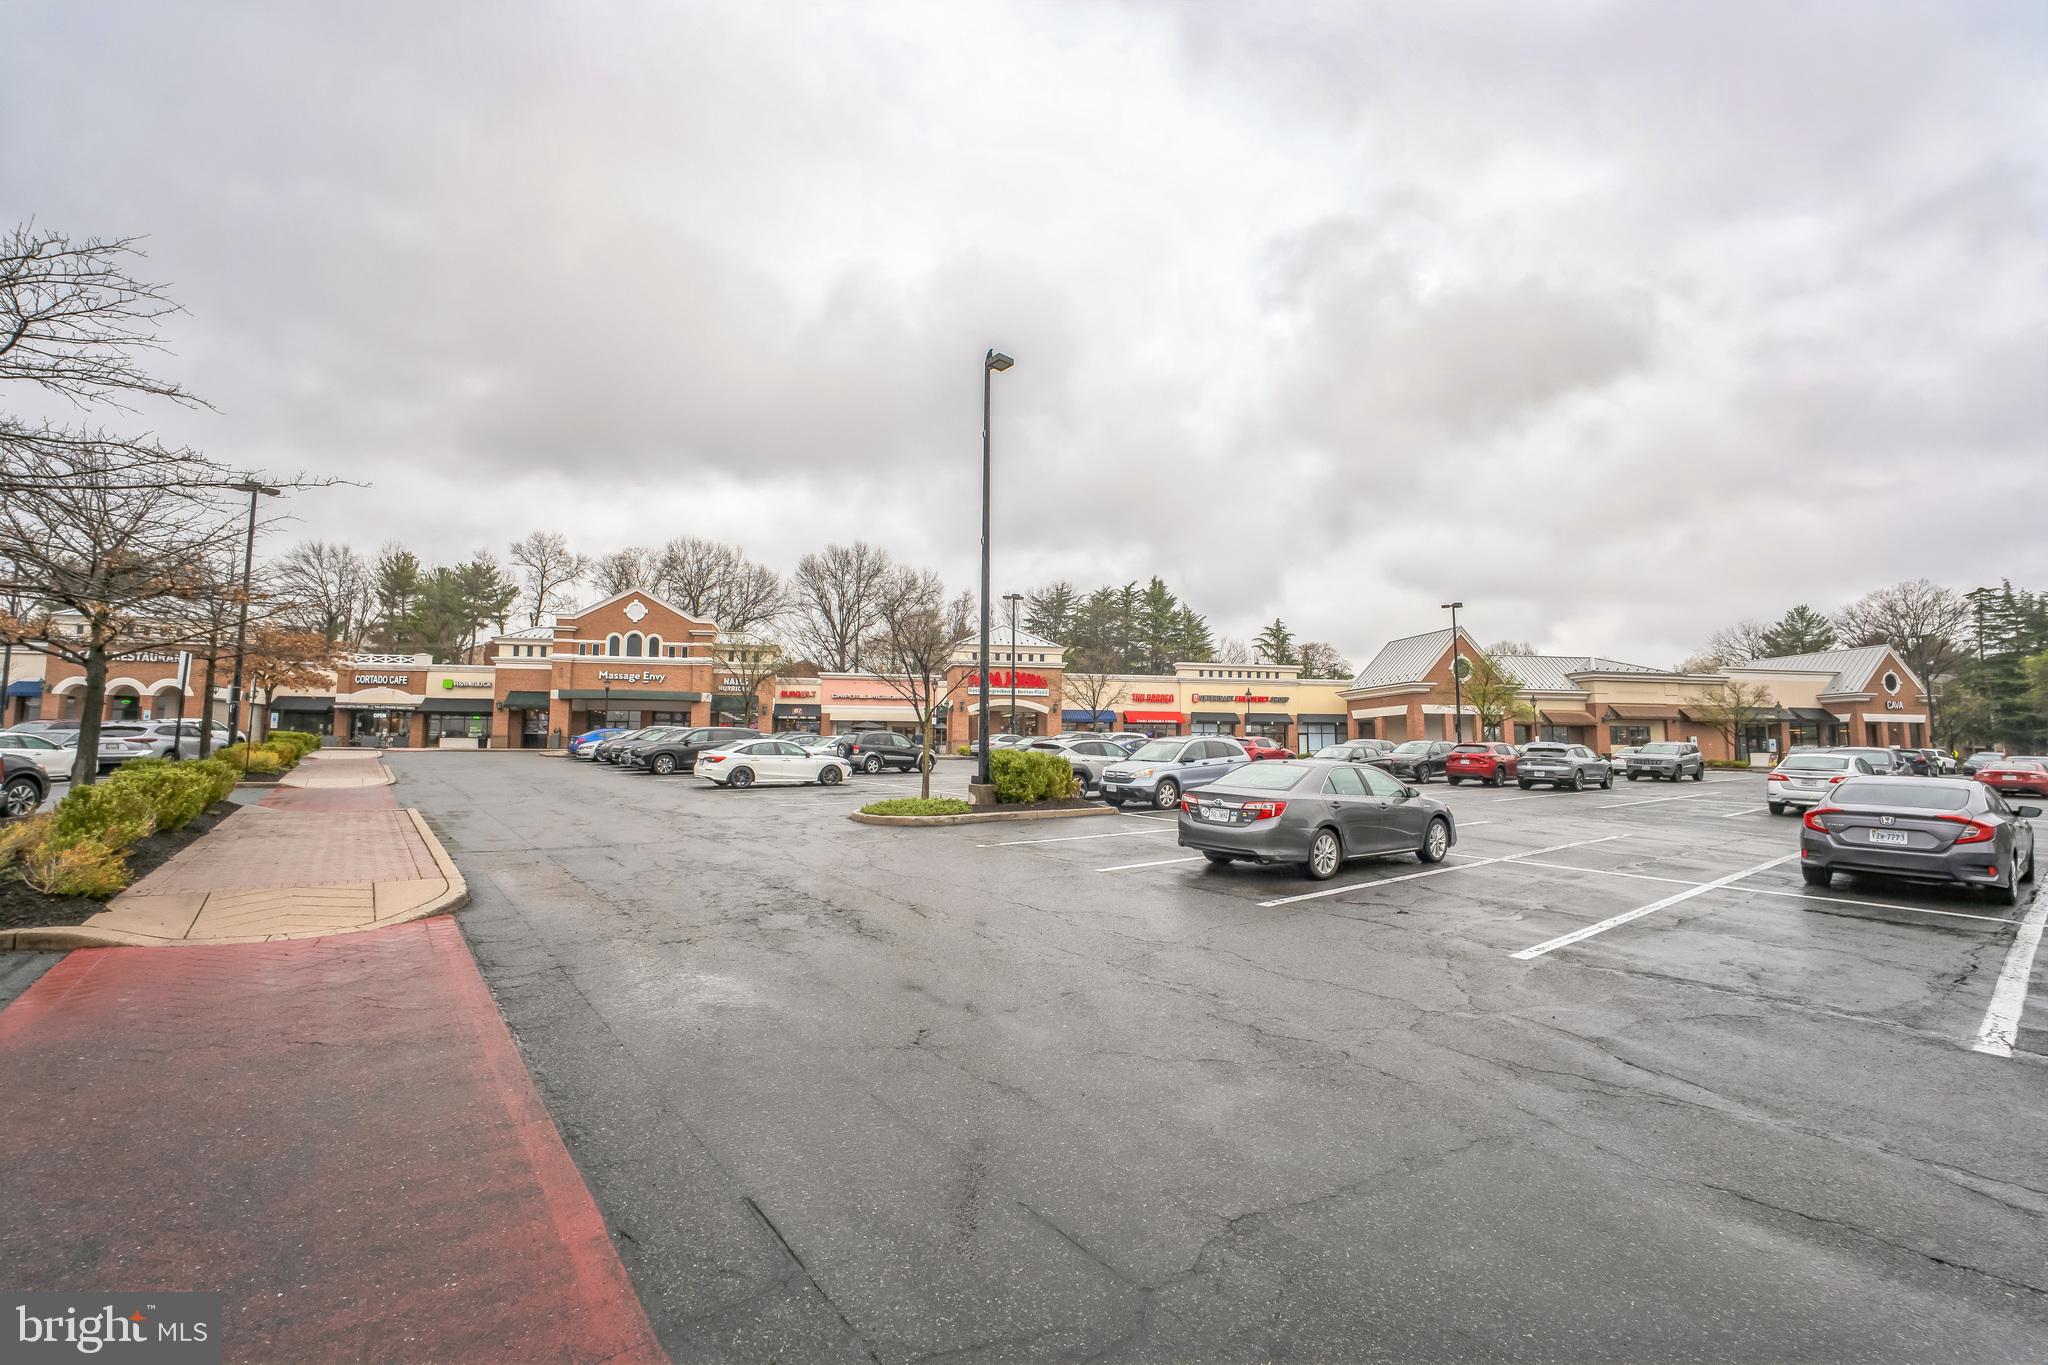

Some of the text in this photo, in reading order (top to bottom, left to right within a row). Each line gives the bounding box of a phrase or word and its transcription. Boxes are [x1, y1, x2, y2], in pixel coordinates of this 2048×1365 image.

[355, 675, 408, 684] CORTADO CAFE
[599, 670, 666, 683] Massage Envy
[968, 672, 1003, 688] PPA
[723, 677, 749, 686] NAILS
[1886, 701, 1904, 709] CAVA
